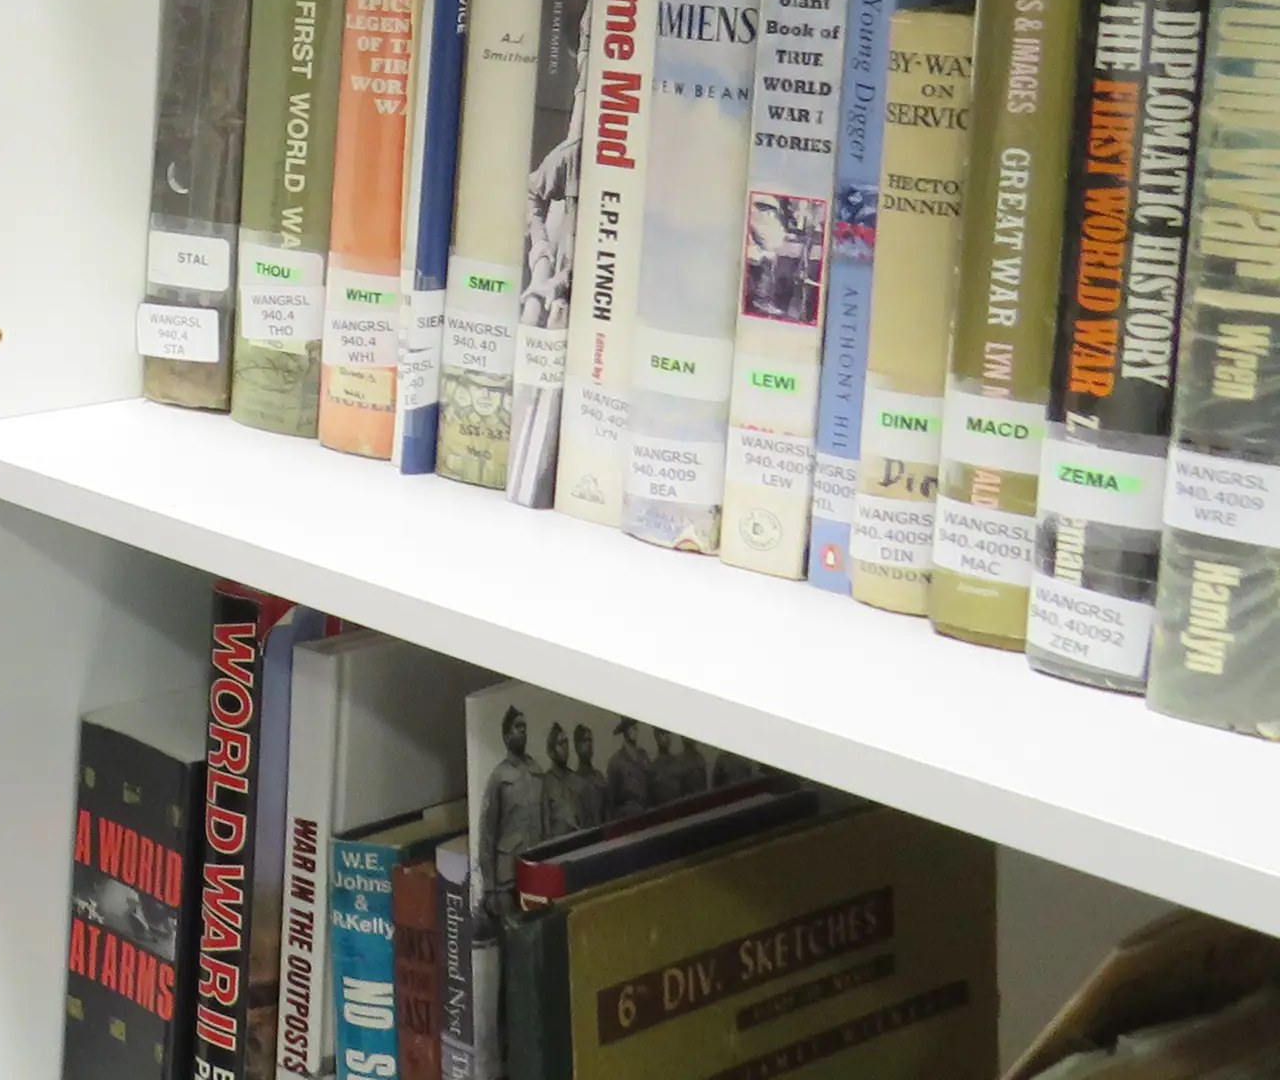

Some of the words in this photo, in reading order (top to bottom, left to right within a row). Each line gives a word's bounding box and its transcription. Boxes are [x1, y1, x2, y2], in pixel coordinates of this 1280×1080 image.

[291, 0, 317, 80] FIRST
[765, 20, 814, 39] Book
[819, 23, 840, 41] of
[1093, 2, 1147, 73] THE
[356, 36, 383, 52] OF
[775, 49, 825, 68] TRUE
[762, 76, 833, 97] WORLD
[1006, 36, 1041, 115] IMAGES
[694, 83, 750, 101] BEAN
[920, 83, 955, 102] ON
[596, 70, 643, 170] Mud
[767, 104, 811, 124] WAR
[843, 83, 876, 164] Digger
[1136, 9, 1202, 228] DIPLOMATIC
[283, 92, 311, 194] WORLD
[754, 132, 832, 155] STORIES
[1086, 79, 1139, 184] FIRST
[992, 147, 1032, 251] GREAT
[598, 190, 621, 243] E.P.F.
[176, 251, 209, 267] STAL
[1075, 186, 1132, 312] WORLD
[254, 261, 291, 280] THOU
[345, 287, 382, 305] WHIT
[468, 275, 506, 294] SMIT
[592, 249, 618, 322] LYNCH
[986, 255, 1022, 328] WAR
[251, 294, 311, 307] WANGRSL
[1121, 233, 1181, 389] HISTORY
[148, 312, 203, 329] WANGRSL
[260, 309, 295, 322] 940.4
[331, 319, 394, 333] WANGRSL
[156, 328, 189, 342] 940.4
[268, 324, 294, 337] THO
[447, 316, 513, 340] WANGRSL
[163, 342, 186, 356] STA
[340, 334, 377, 348] 940.4
[452, 334, 498, 353] 940.40
[836, 285, 860, 405] ANTHONY
[348, 349, 376, 364] WHI
[462, 351, 488, 368] SMI
[649, 354, 697, 376] BEAN
[1066, 318, 1120, 398] WAR
[750, 371, 797, 392] LEWI
[880, 411, 929, 433] DINN
[965, 416, 1030, 440] MACD
[632, 445, 702, 467] WANGRSL
[631, 462, 697, 482] 940.4009
[760, 472, 793, 491] LEW
[1057, 465, 1120, 493] ZEMA
[1175, 461, 1269, 492] WANGRSL
[649, 482, 678, 499] BEA
[1194, 508, 1239, 528] WRE
[879, 547, 915, 564] DIN
[960, 553, 1002, 577] MAC
[1036, 587, 1125, 627] WANGRSL
[1181, 559, 1242, 677] Hamlyn
[1048, 633, 1091, 659] ZEM
[205, 621, 257, 856] WORLD
[291, 816, 318, 874] WAR
[73, 809, 92, 869] A
[98, 816, 185, 909] WORLD
[341, 850, 386, 873] W.E.
[290, 873, 316, 906] IN
[333, 873, 392, 895] Johns
[353, 894, 369, 913] &
[197, 864, 246, 1007] WAR
[288, 906, 315, 954] THE
[446, 891, 465, 983] Edmond
[662, 958, 722, 1012] DIV.
[737, 900, 879, 982] SKETCHES
[69, 917, 100, 980] AT
[100, 930, 176, 1023] ARMS
[285, 955, 313, 1076] OUTPOSTS
[343, 976, 396, 1031] NO
[195, 1005, 238, 1052] II
